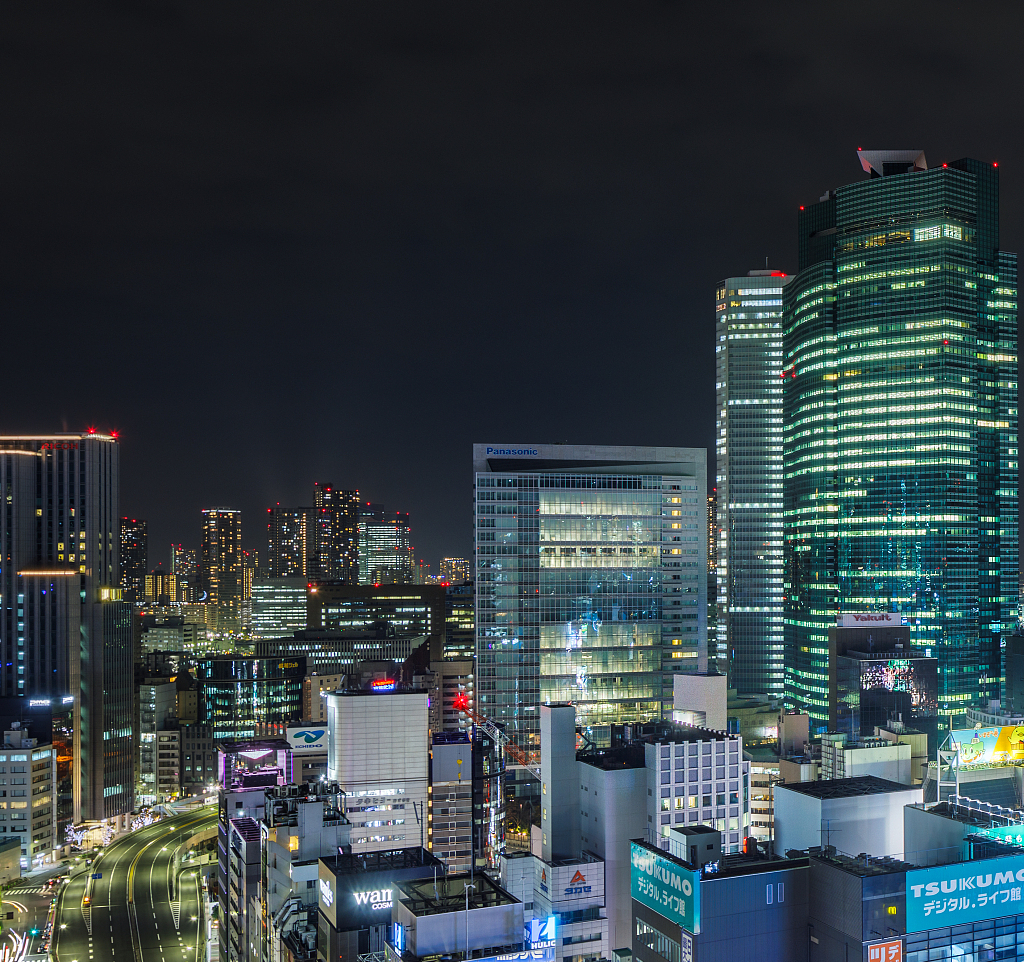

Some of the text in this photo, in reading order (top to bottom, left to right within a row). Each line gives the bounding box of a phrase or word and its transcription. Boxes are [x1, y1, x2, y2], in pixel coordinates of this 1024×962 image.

[41, 442, 79, 450] RICOH
[486, 447, 538, 455] Panasonic
[853, 614, 892, 622] Yakult
[633, 852, 693, 897] TSUKUMO
[531, 940, 556, 949] HULIC
